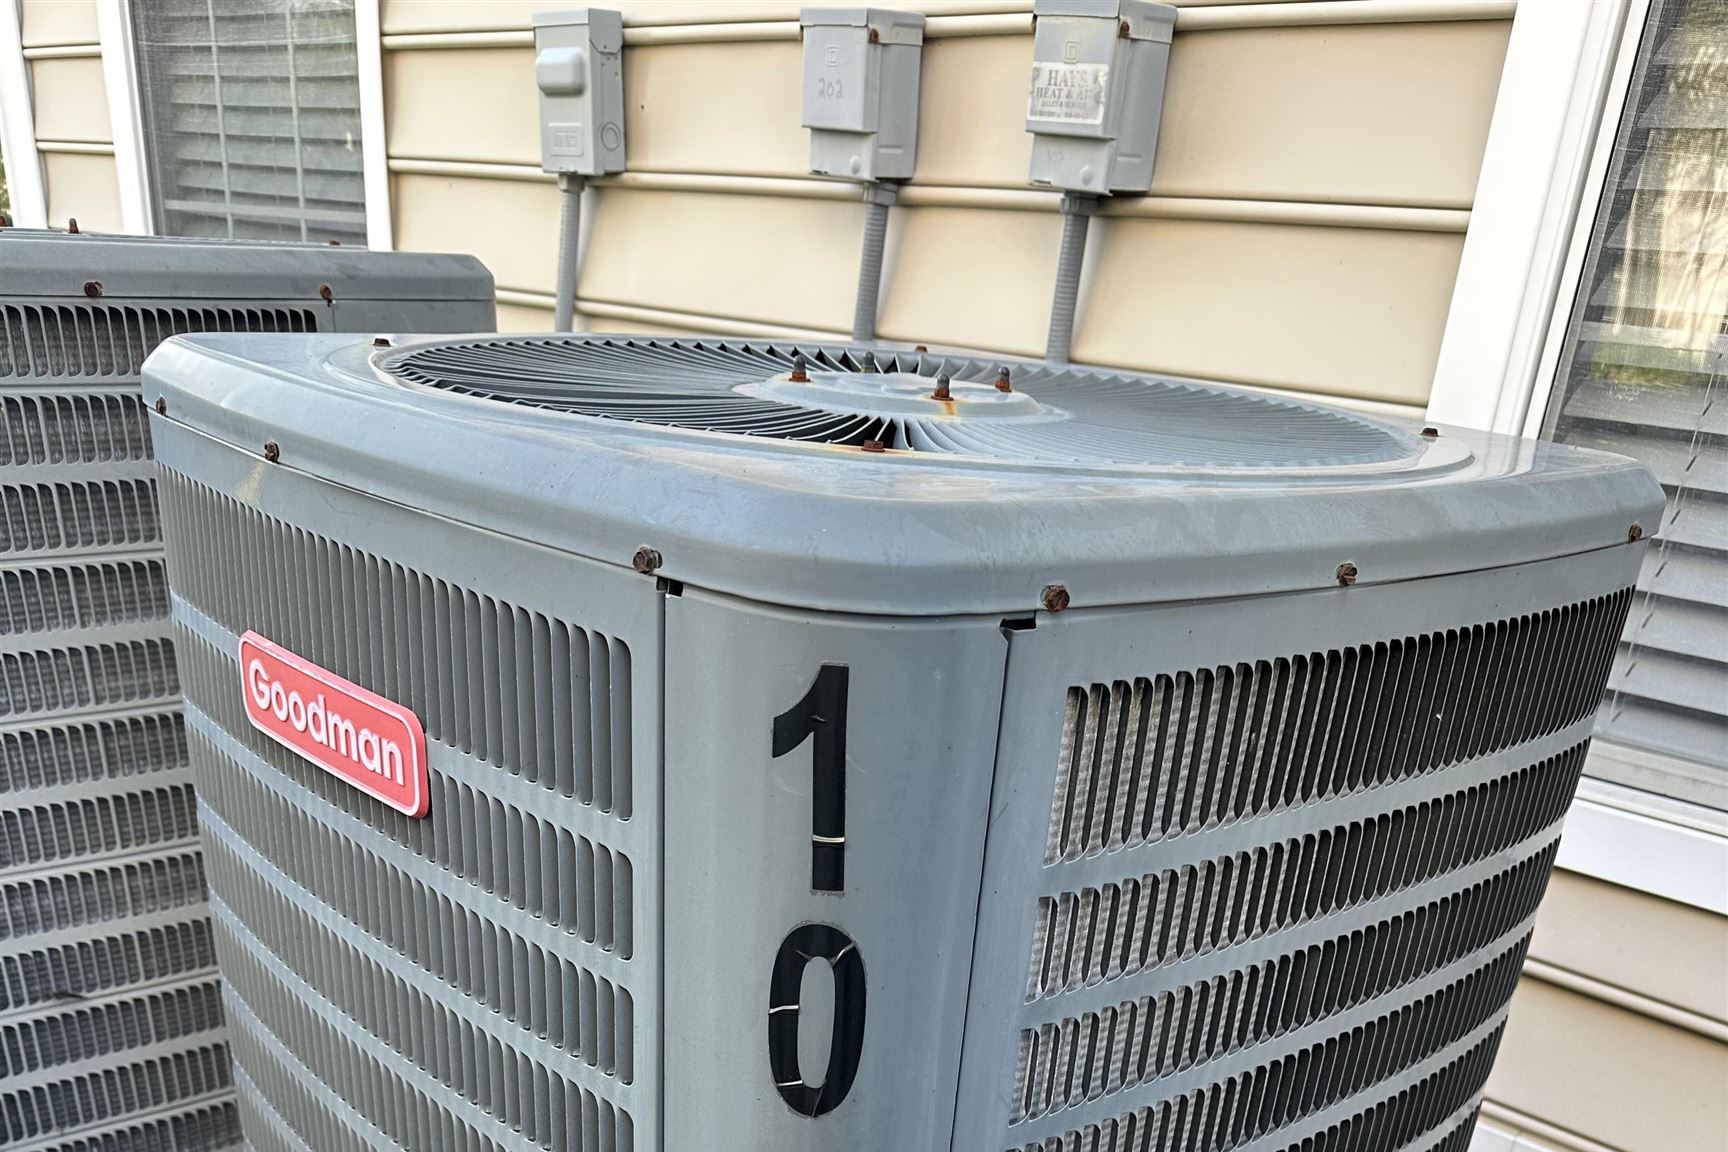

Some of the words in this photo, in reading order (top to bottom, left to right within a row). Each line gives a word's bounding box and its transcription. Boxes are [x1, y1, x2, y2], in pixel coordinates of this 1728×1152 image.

[818, 77, 843, 100] 202
[1036, 87, 1064, 99] HEAT
[1065, 88, 1073, 99] &
[249, 658, 405, 787] Goodman
